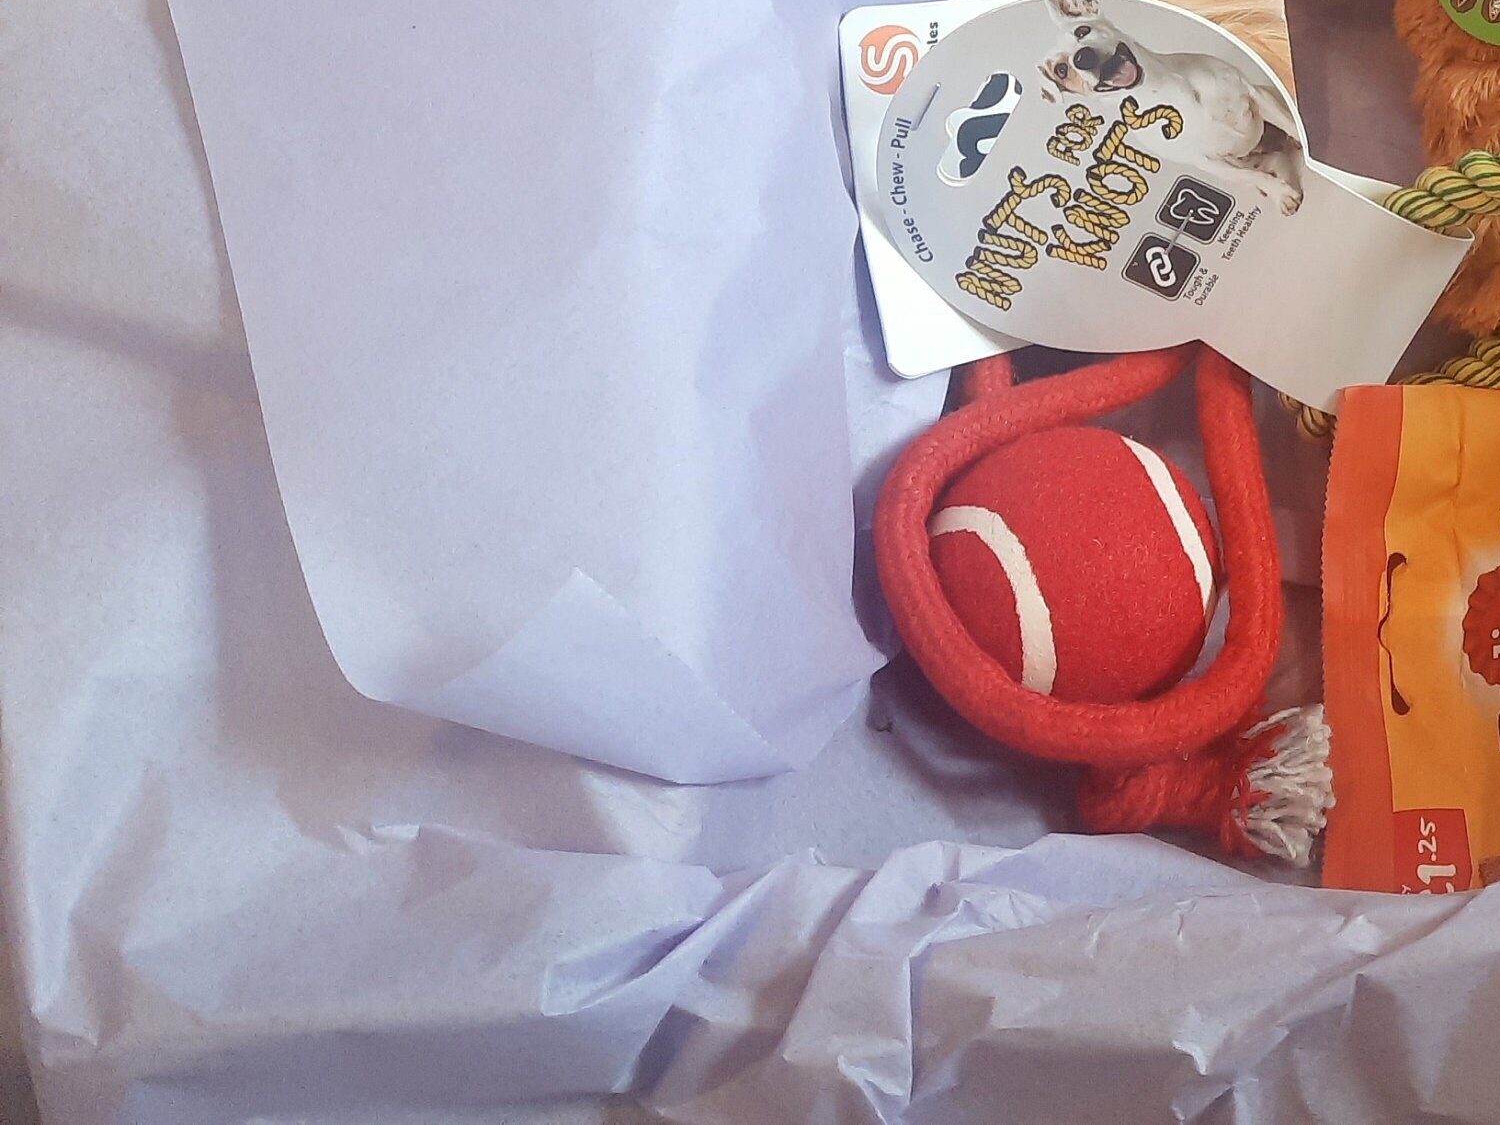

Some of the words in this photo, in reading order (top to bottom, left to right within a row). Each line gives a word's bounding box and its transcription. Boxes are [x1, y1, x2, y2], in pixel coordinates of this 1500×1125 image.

[926, 21, 938, 48] les
[890, 117, 912, 150] Pull
[890, 161, 908, 206] Chew
[1046, 95, 1184, 272] KNOTS
[903, 217, 934, 263] Chase
[955, 165, 1072, 312] NUTS
[1217, 210, 1245, 245] Keeping
[1221, 238, 1242, 261] Teeth
[1236, 205, 1262, 239] Healthy
[1183, 274, 1204, 300] Tough
[1199, 267, 1208, 275] &
[1194, 274, 1220, 307] Durable
